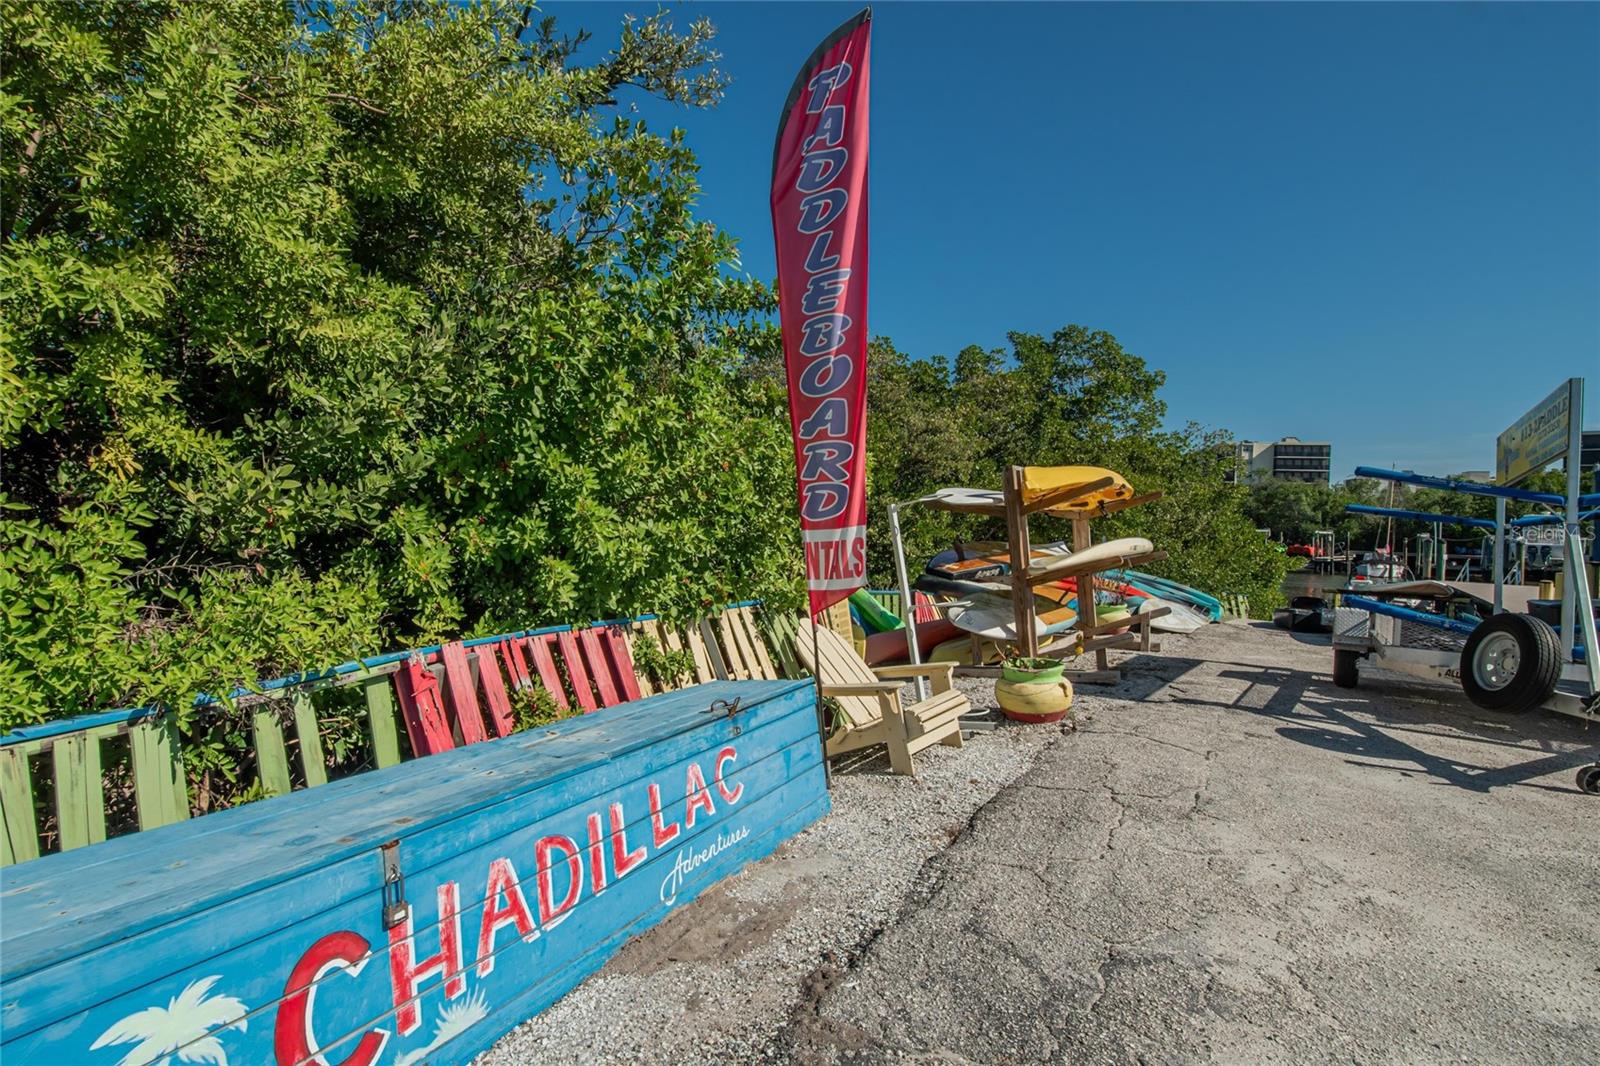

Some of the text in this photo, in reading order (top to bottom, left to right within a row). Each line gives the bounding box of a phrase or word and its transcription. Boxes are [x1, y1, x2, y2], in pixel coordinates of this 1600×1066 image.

[796, 62, 854, 522] PADDLEBOARD
[273, 745, 746, 1066] CHADILLAC
[660, 825, 751, 906] Adventures
